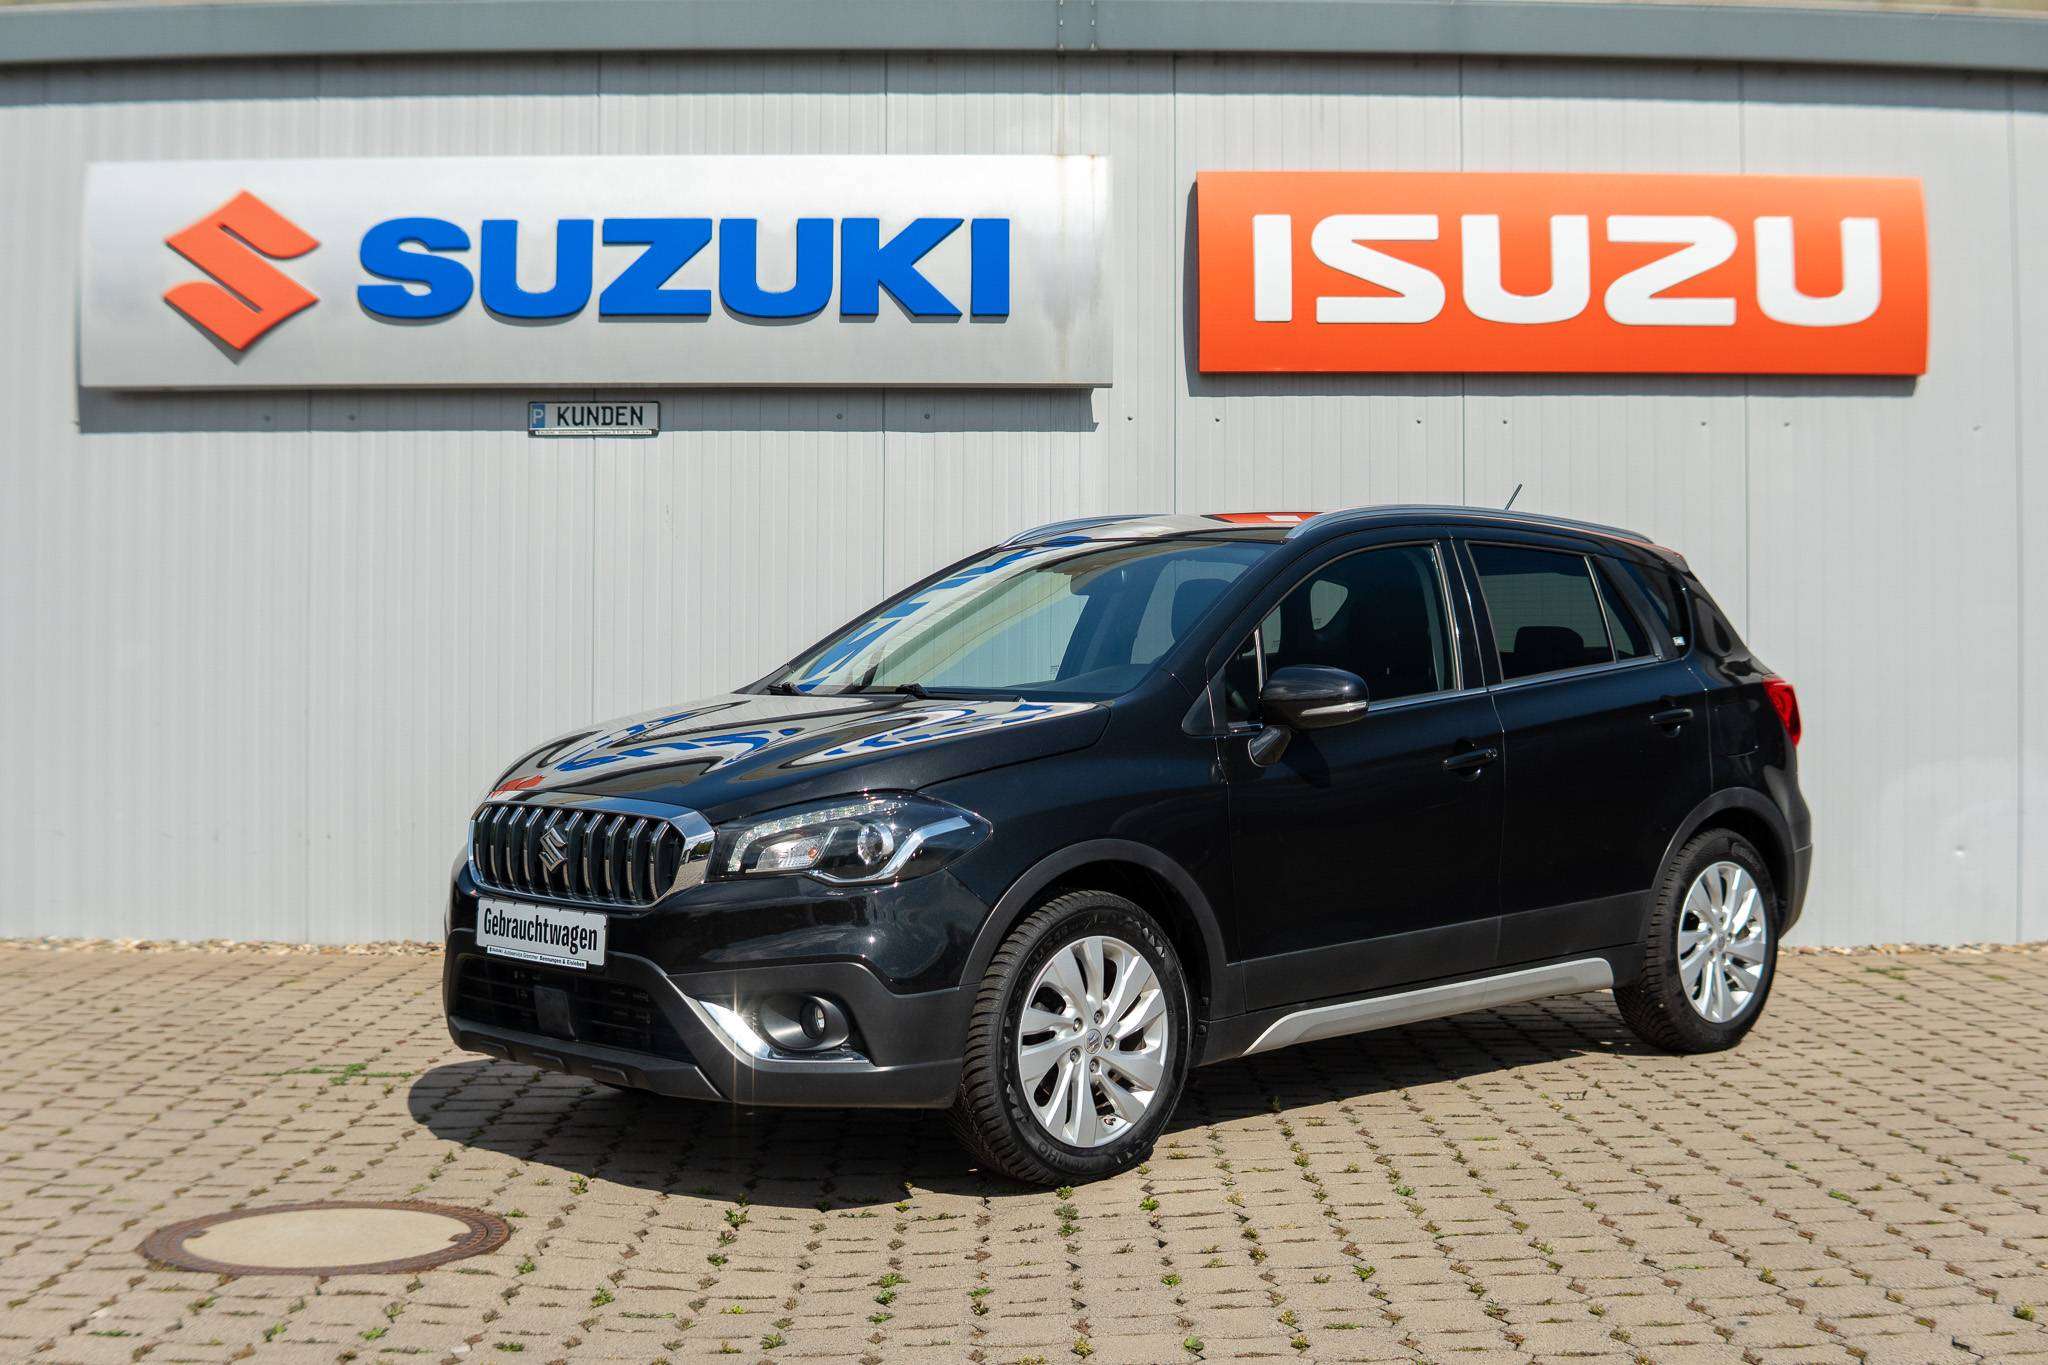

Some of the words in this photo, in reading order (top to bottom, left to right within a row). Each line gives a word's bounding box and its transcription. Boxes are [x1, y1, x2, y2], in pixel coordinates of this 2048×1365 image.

[357, 217, 1010, 319] SUZUKI
[1253, 214, 1881, 327] ISUZU
[533, 408, 544, 424] P
[557, 406, 643, 427] KUNDEN
[484, 908, 598, 955] Gebrauchtwagen
